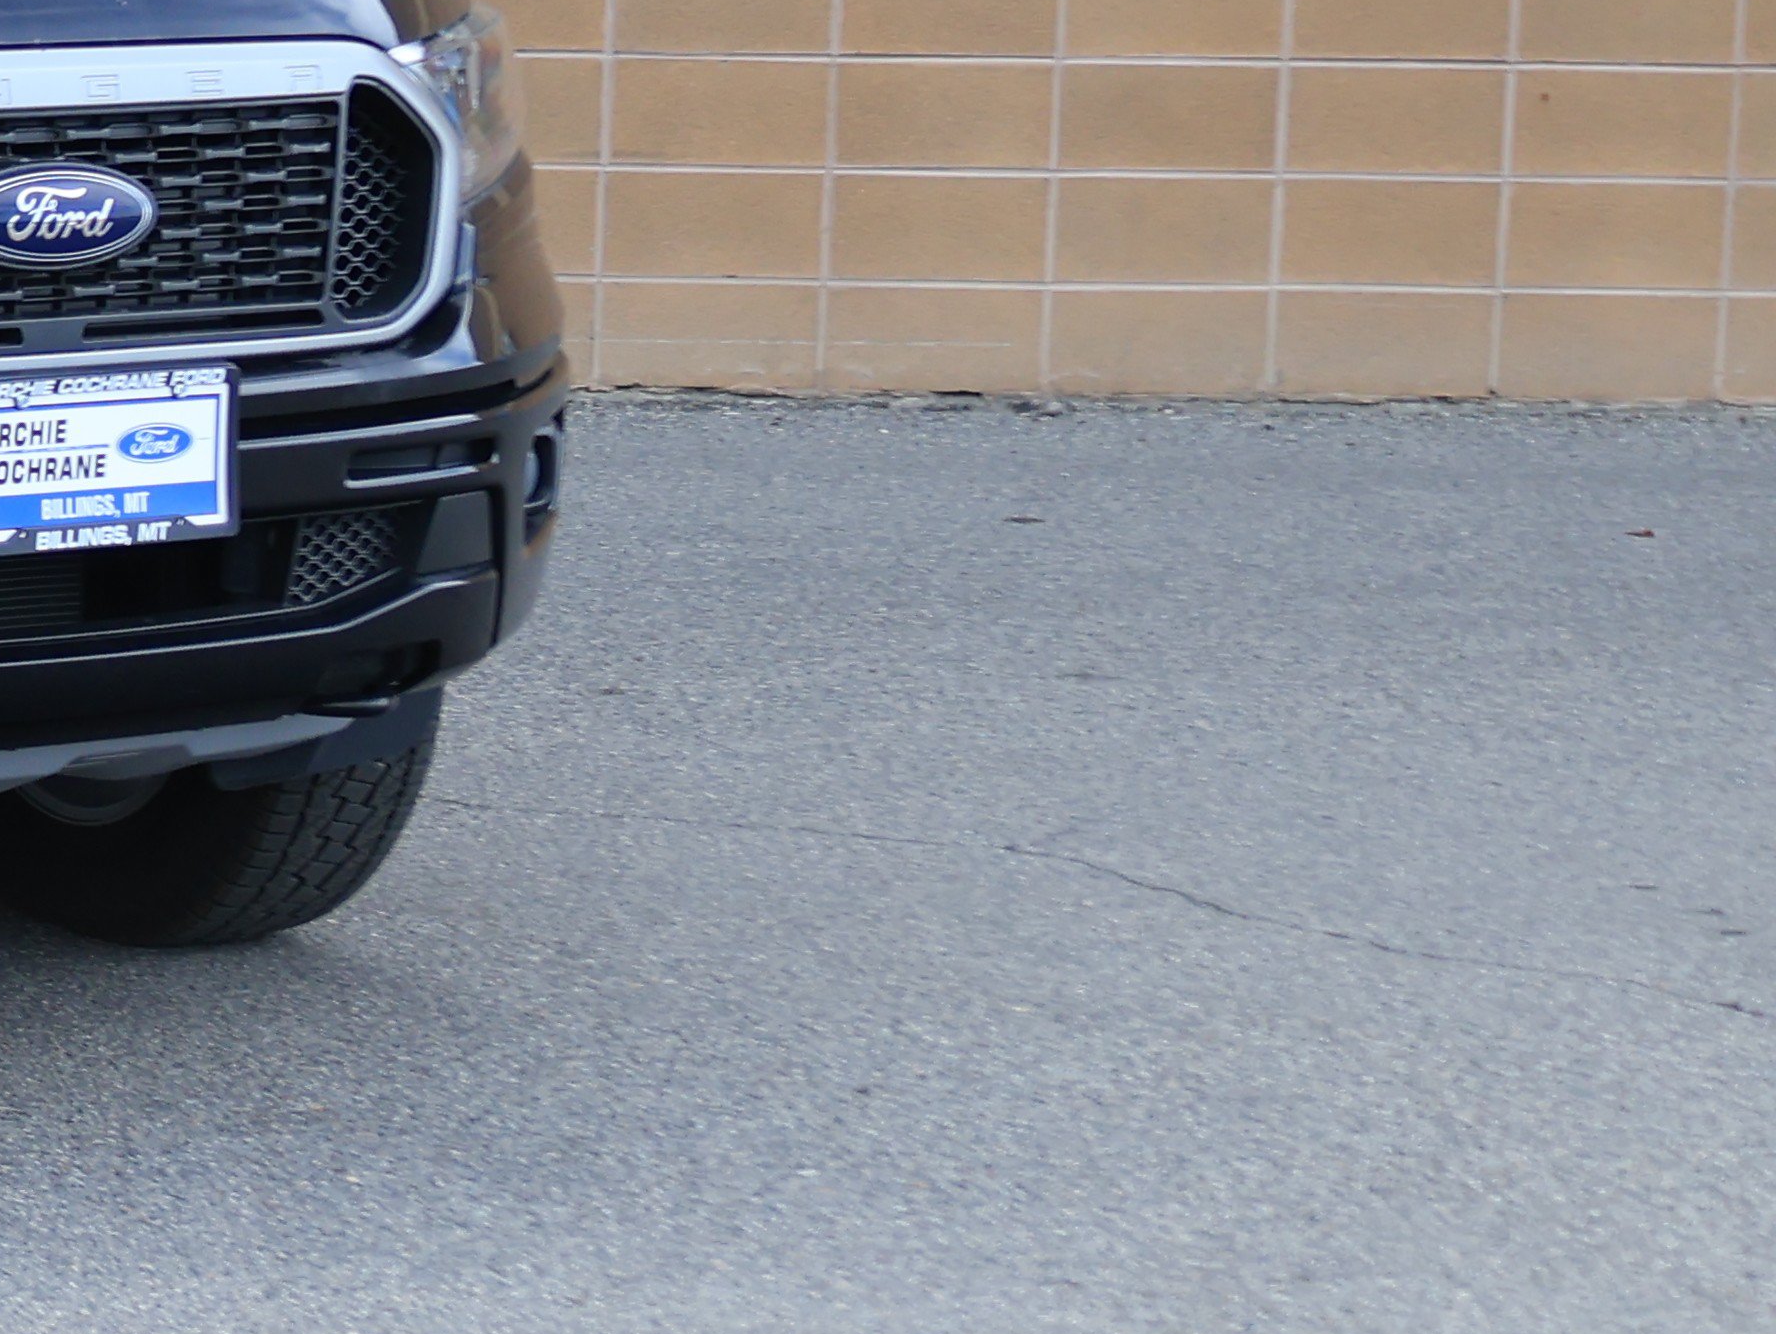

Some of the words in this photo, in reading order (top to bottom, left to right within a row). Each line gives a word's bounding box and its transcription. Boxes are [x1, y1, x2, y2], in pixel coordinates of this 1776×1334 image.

[6, 186, 115, 242] Ford
[57, 371, 169, 395] COCHRANE
[169, 367, 227, 386] FORD
[128, 428, 181, 456] Ford
[40, 493, 121, 520] BILLINGS,
[123, 491, 150, 514] MT
[35, 524, 133, 551] BILLINGS,
[137, 521, 173, 543] MT
